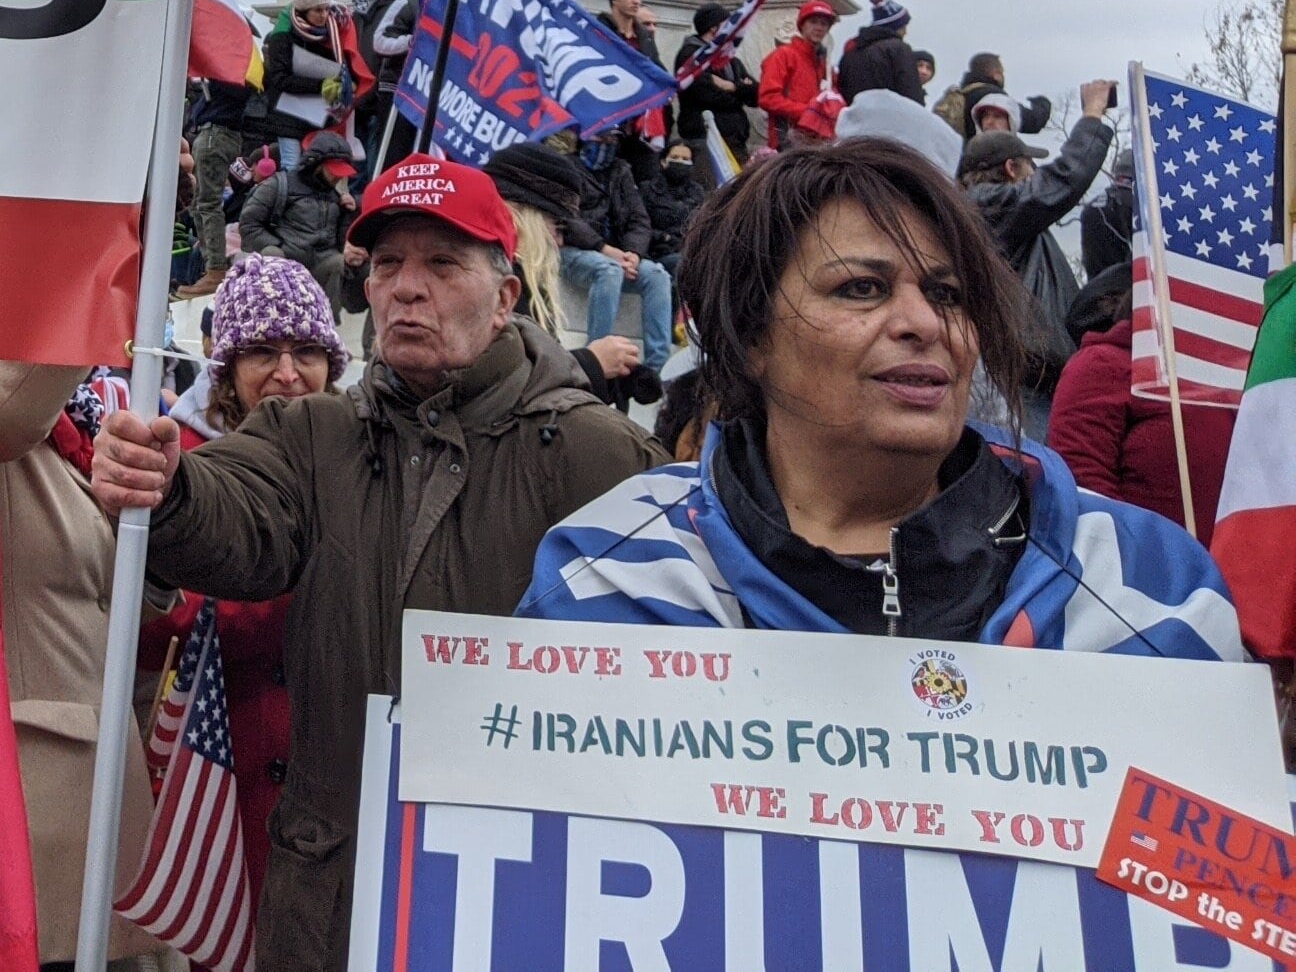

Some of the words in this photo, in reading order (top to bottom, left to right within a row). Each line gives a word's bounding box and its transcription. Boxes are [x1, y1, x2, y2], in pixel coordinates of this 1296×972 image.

[437, 79, 482, 131] MORE
[472, 109, 529, 152] BU
[397, 163, 440, 178] KEEP
[381, 178, 456, 198] AMERICA
[389, 192, 443, 205] GREAT
[421, 634, 489, 665] WE
[506, 642, 621, 675] LOVE
[644, 650, 732, 681] YOU
[917, 649, 956, 661] VOTED
[926, 709, 932, 717] I
[937, 702, 973, 720] VOTED
[787, 719, 891, 769] FOR
[907, 731, 1108, 789] TRUMP
[710, 783, 787, 819] WE
[809, 792, 946, 836] LOVE
[971, 810, 1086, 852] YOU
[1117, 857, 1189, 902] STOP
[1197, 892, 1244, 931] the
